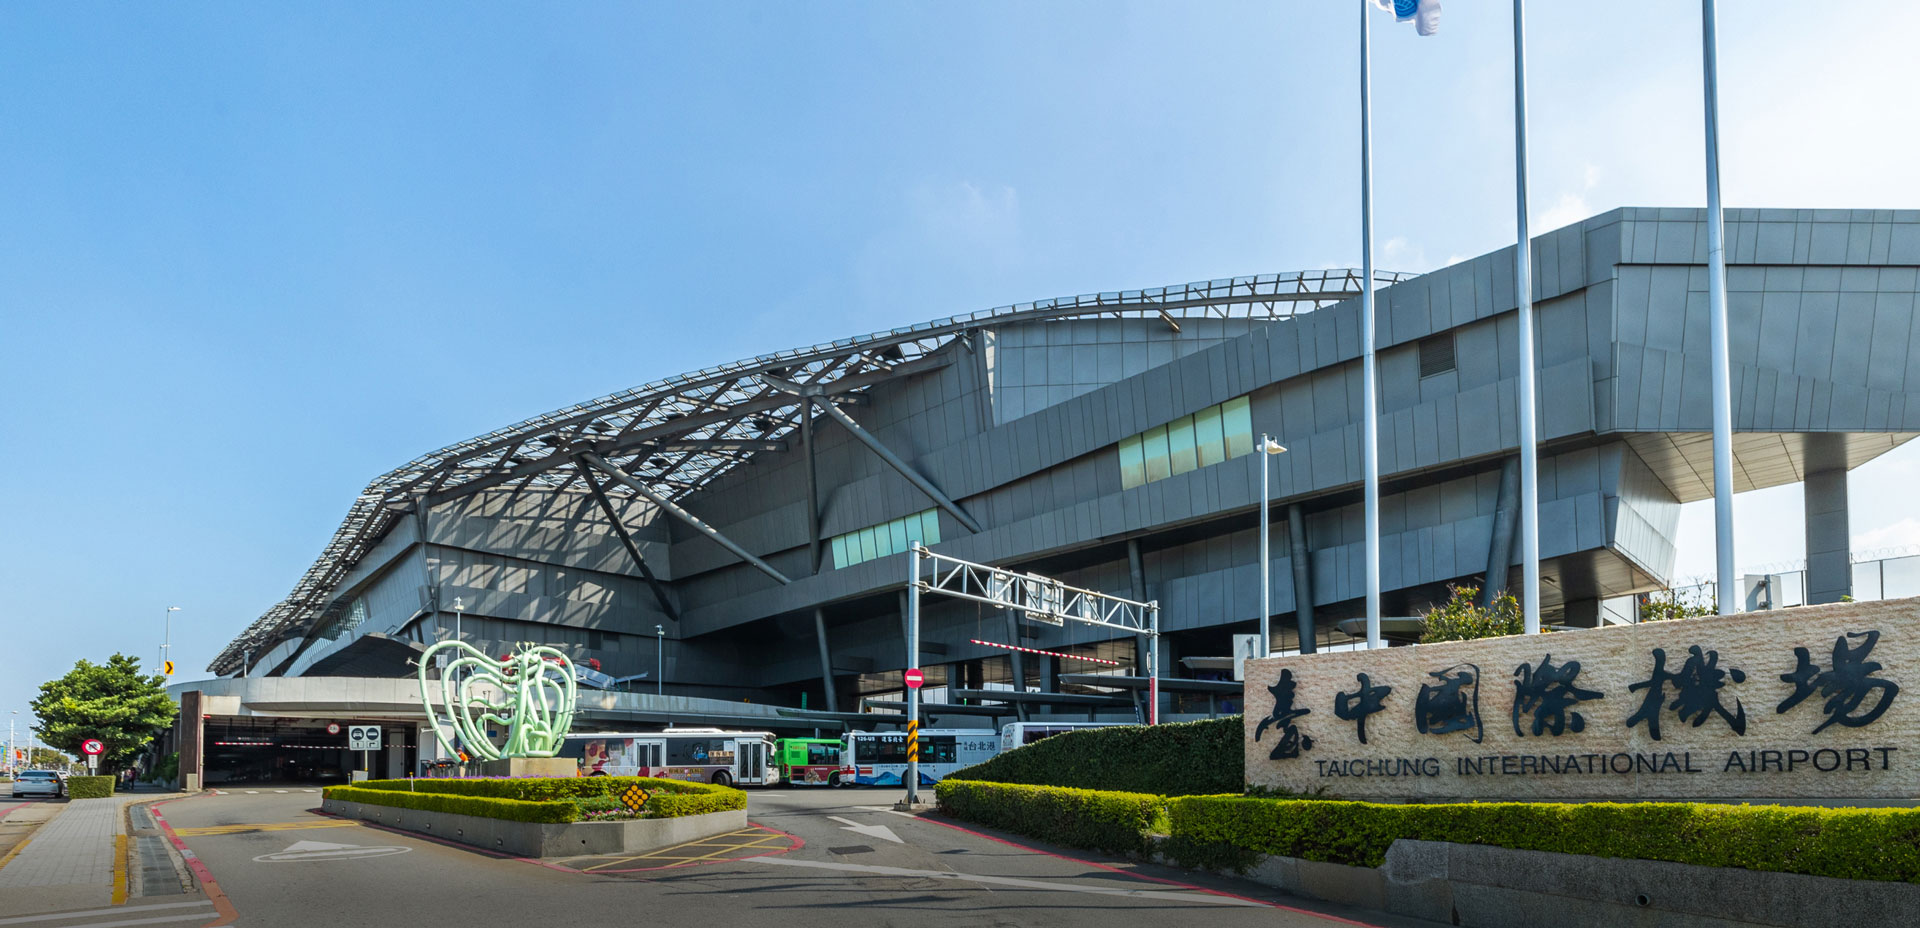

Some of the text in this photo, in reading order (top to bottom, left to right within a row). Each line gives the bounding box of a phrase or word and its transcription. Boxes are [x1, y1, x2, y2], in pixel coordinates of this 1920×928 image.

[1255, 630, 1900, 760] 臺中國際機場
[1314, 747, 1898, 778] TAICHUNG INTERNATIONAL AIRPORT
